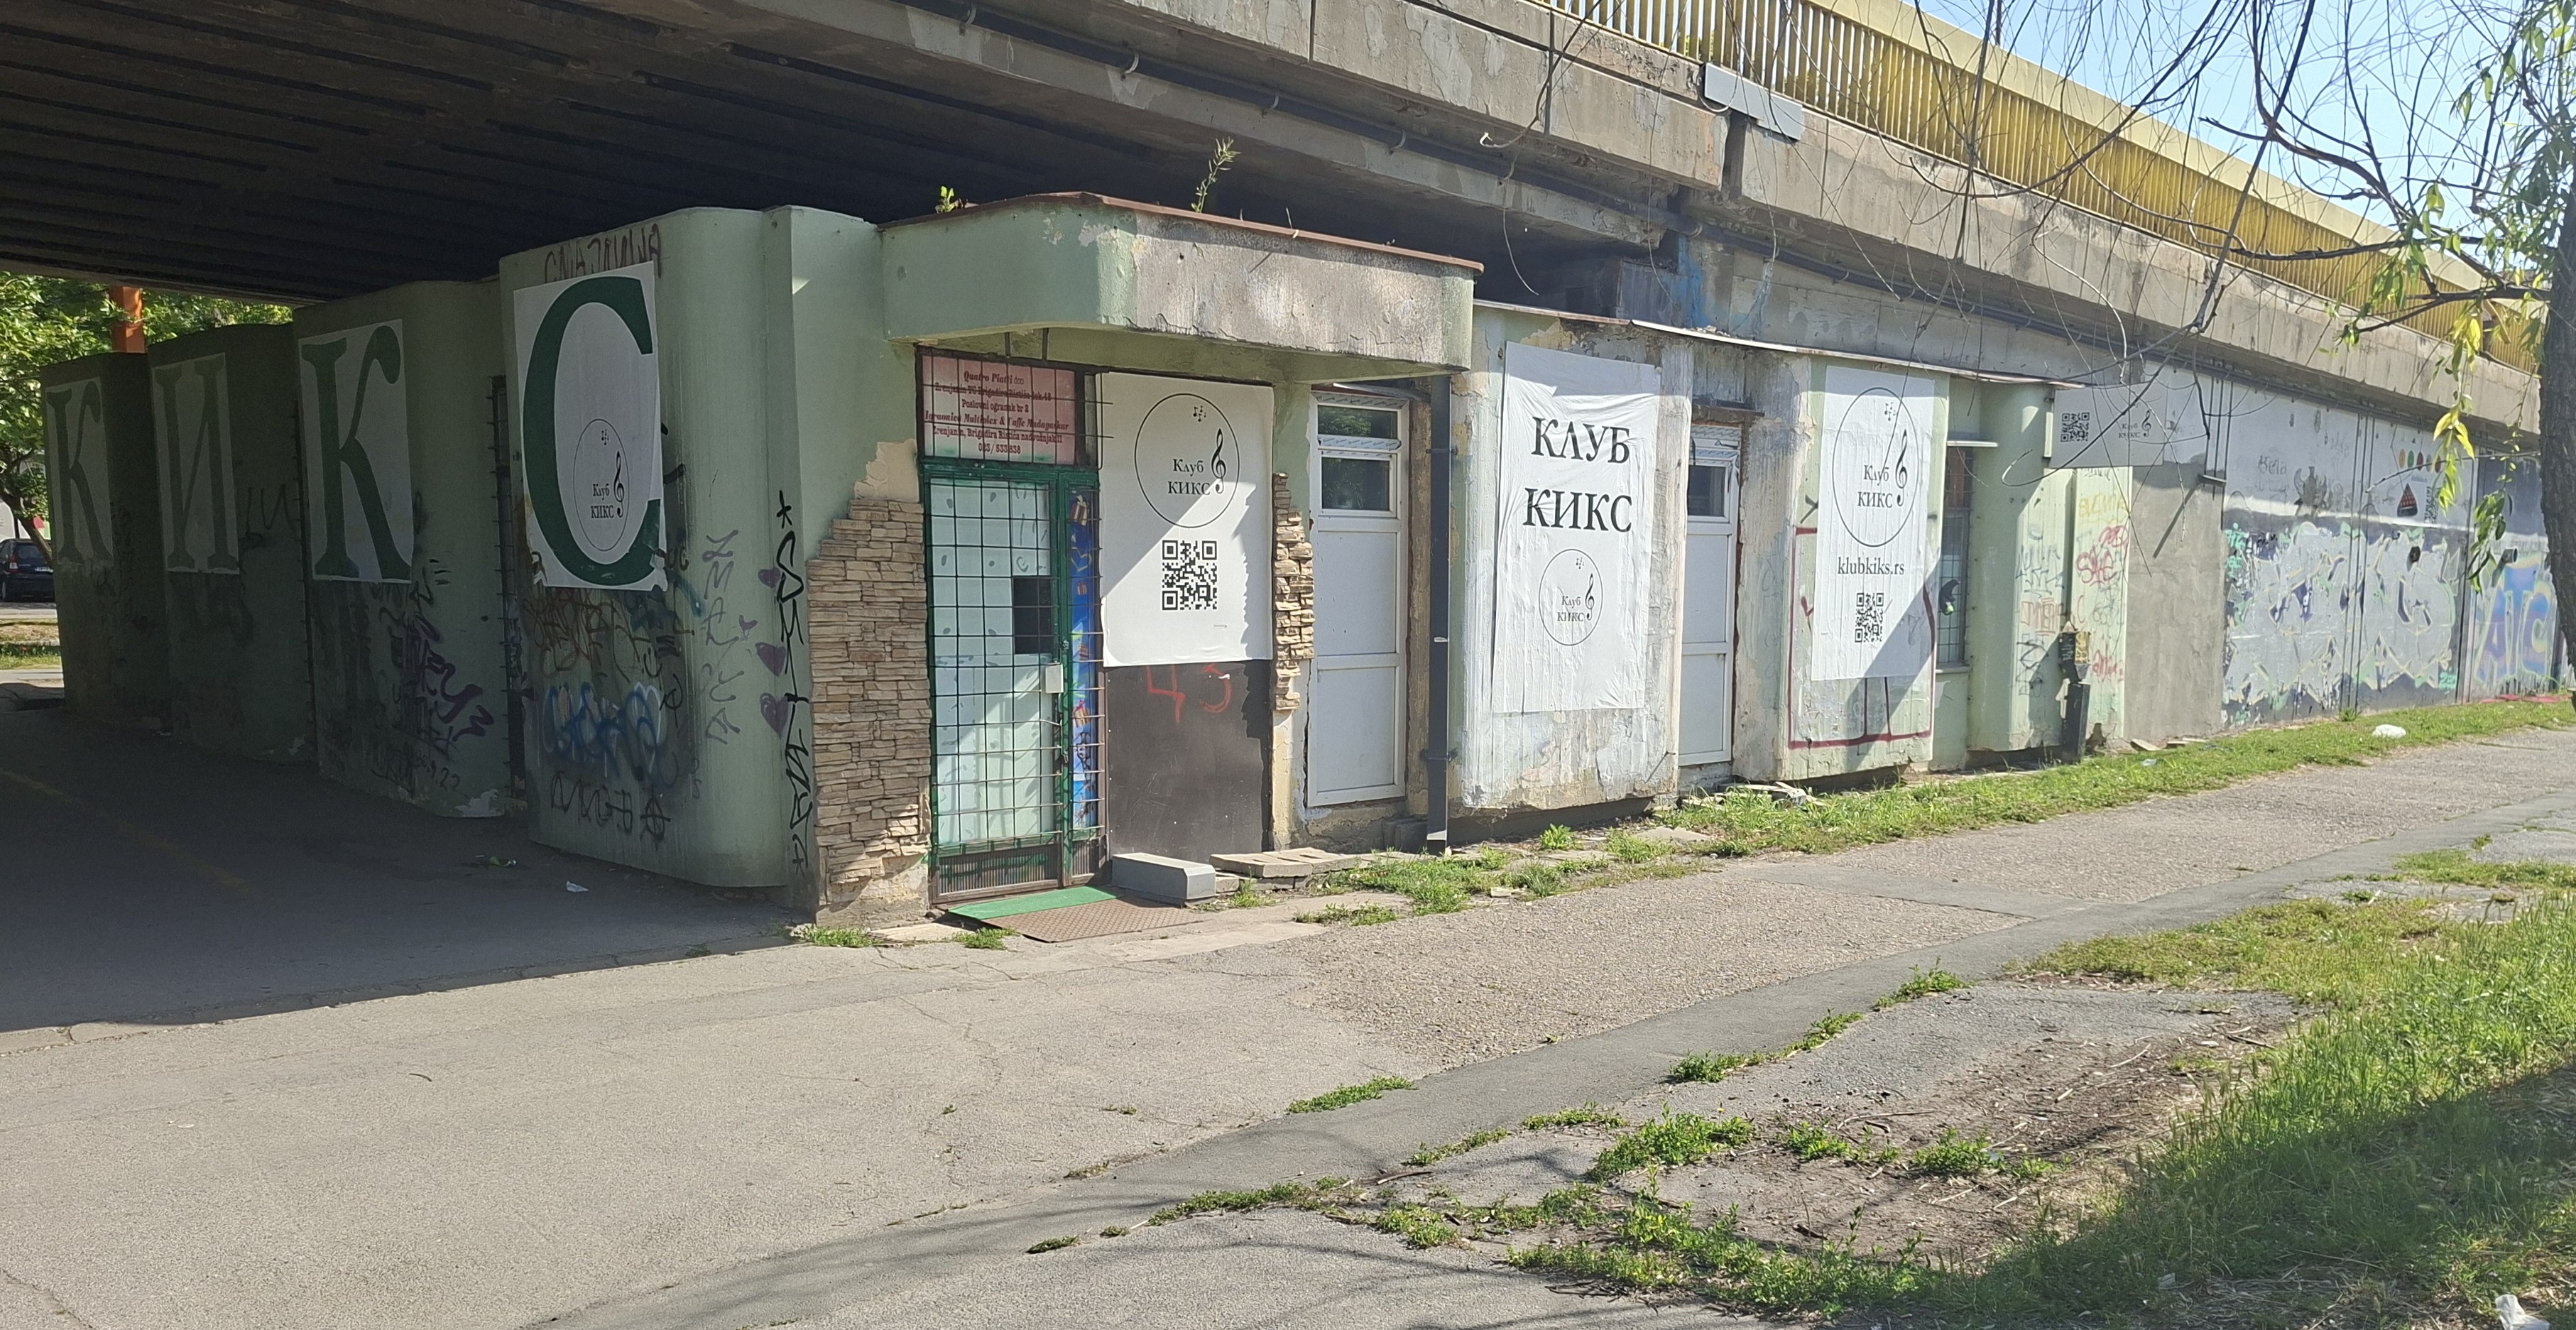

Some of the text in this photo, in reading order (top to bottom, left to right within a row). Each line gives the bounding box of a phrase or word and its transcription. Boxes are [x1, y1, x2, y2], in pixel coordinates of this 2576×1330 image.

[934, 425, 966, 439] Zrenjann,
[1531, 416, 1630, 463] КЛУБ
[1172, 458, 1204, 476] Клуб
[1864, 465, 1889, 486] Клуб
[593, 484, 611, 501] Клуб
[1167, 481, 1211, 496] КИКС
[1857, 491, 1893, 508] КИКС
[591, 506, 614, 519] КИКС
[1522, 487, 1632, 533] КИКС
[1837, 557, 1905, 575] klubkiks.rs
[1562, 596, 1581, 609] Клуб
[1557, 611, 1585, 622] КИКС
